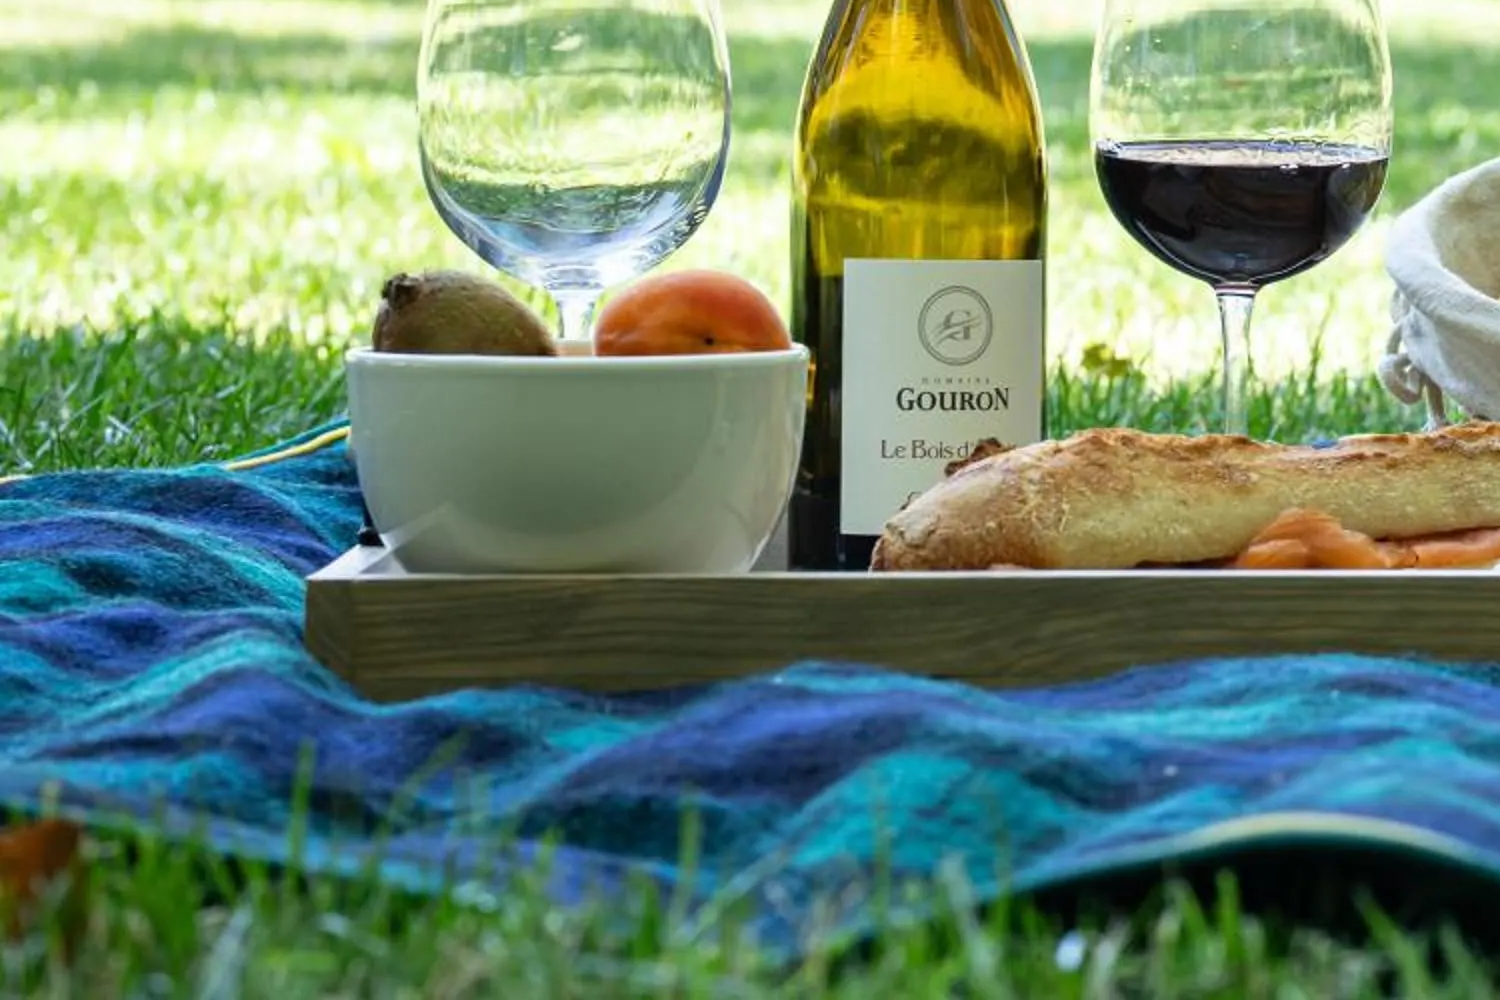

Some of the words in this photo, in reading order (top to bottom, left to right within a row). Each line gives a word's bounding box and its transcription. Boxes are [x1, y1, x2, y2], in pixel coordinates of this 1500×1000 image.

[896, 386, 1009, 412] GOURON
[881, 439, 906, 459] Le
[911, 439, 954, 459] Bois
